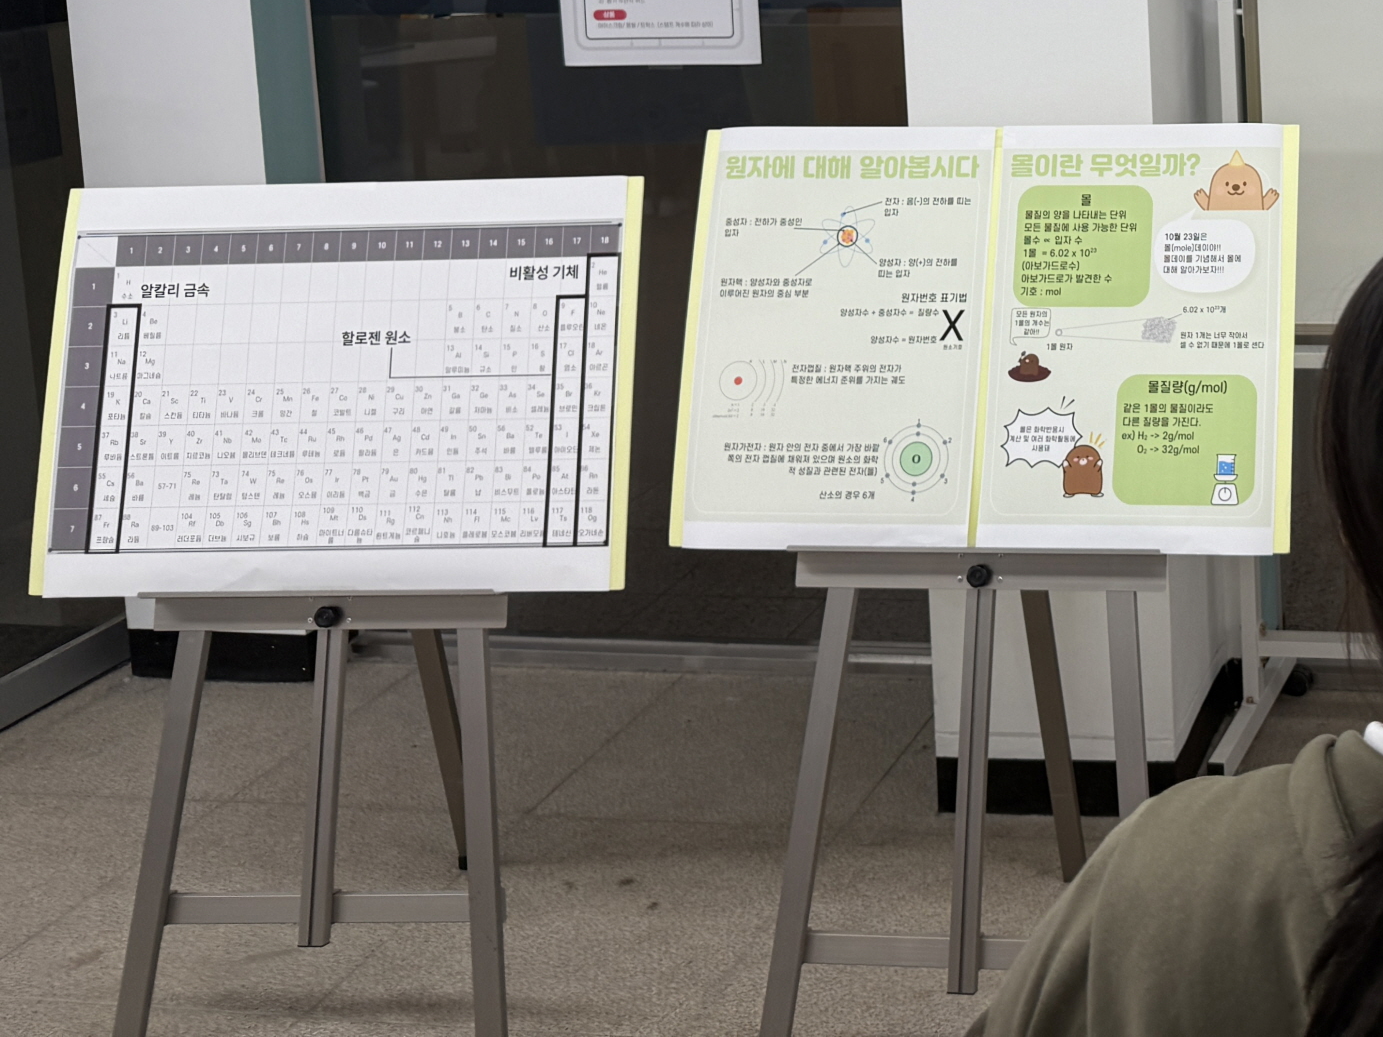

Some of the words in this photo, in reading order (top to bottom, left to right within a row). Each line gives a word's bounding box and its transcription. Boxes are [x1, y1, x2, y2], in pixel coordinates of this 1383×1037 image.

[726, 156, 795, 179] 원자에
[803, 156, 851, 179] 대해
[860, 155, 979, 179] 알아봅시다
[1011, 154, 1083, 177] 몰이란
[1090, 153, 1200, 177] 무엇일까?
[1082, 194, 1091, 206] 몰
[1026, 210, 1050, 219] 물질의
[1054, 210, 1069, 219] 양을
[1073, 210, 1106, 219] 나타내는
[1110, 210, 1126, 219] 단위
[755, 218, 777, 226] 전하가
[1024, 223, 1040, 232] 모든
[1045, 223, 1069, 232] 물질에
[1073, 223, 1089, 232] 사용
[1092, 223, 1117, 232] 가능한
[1121, 223, 1137, 232] 단위
[725, 229, 739, 237] 입자
[1165, 233, 1180, 241] 10월
[1184, 233, 1207, 241] 23일은
[1024, 236, 1040, 245] 몰수
[1055, 236, 1071, 245] 입자
[1075, 236, 1082, 245] 수
[1024, 249, 1036, 257] 1몰
[1050, 249, 1069, 257] 6.02
[1022, 261, 1079, 271] (아보가드로수)
[510, 266, 548, 280] 비활성
[553, 265, 578, 279] 기체
[1021, 274, 1072, 283] 아보가드로가
[1076, 274, 1101, 283] 발견한
[1105, 274, 1112, 283] 수
[141, 283, 179, 298] 알칼리
[184, 283, 209, 297] 금속
[753, 289, 774, 298] 원자의
[1021, 287, 1037, 295] 기호
[902, 293, 936, 303] 원자번호
[941, 293, 967, 302] 표기법
[342, 331, 380, 346] 할로젠
[385, 331, 410, 345] 원소
[880, 365, 901, 373] 전자가
[816, 376, 838, 384] 에너지
[866, 376, 888, 384] 가지는
[1149, 380, 1227, 396] 물질량(g/mol)
[1124, 403, 1140, 413] 같은
[1145, 404, 1166, 413] 1몰의
[1170, 404, 1213, 413] 물질이라도
[1123, 417, 1139, 426] 다른
[1144, 417, 1169, 427] 질량을
[1173, 417, 1201, 427] 가진다.
[1122, 430, 1135, 440] ex)
[1163, 431, 1194, 442] 2g/mol
[724, 443, 761, 453] 원자가전자
[1162, 445, 1199, 456] 32g/mol
[820, 491, 842, 499] 산소의
[862, 491, 875, 499] 6개
